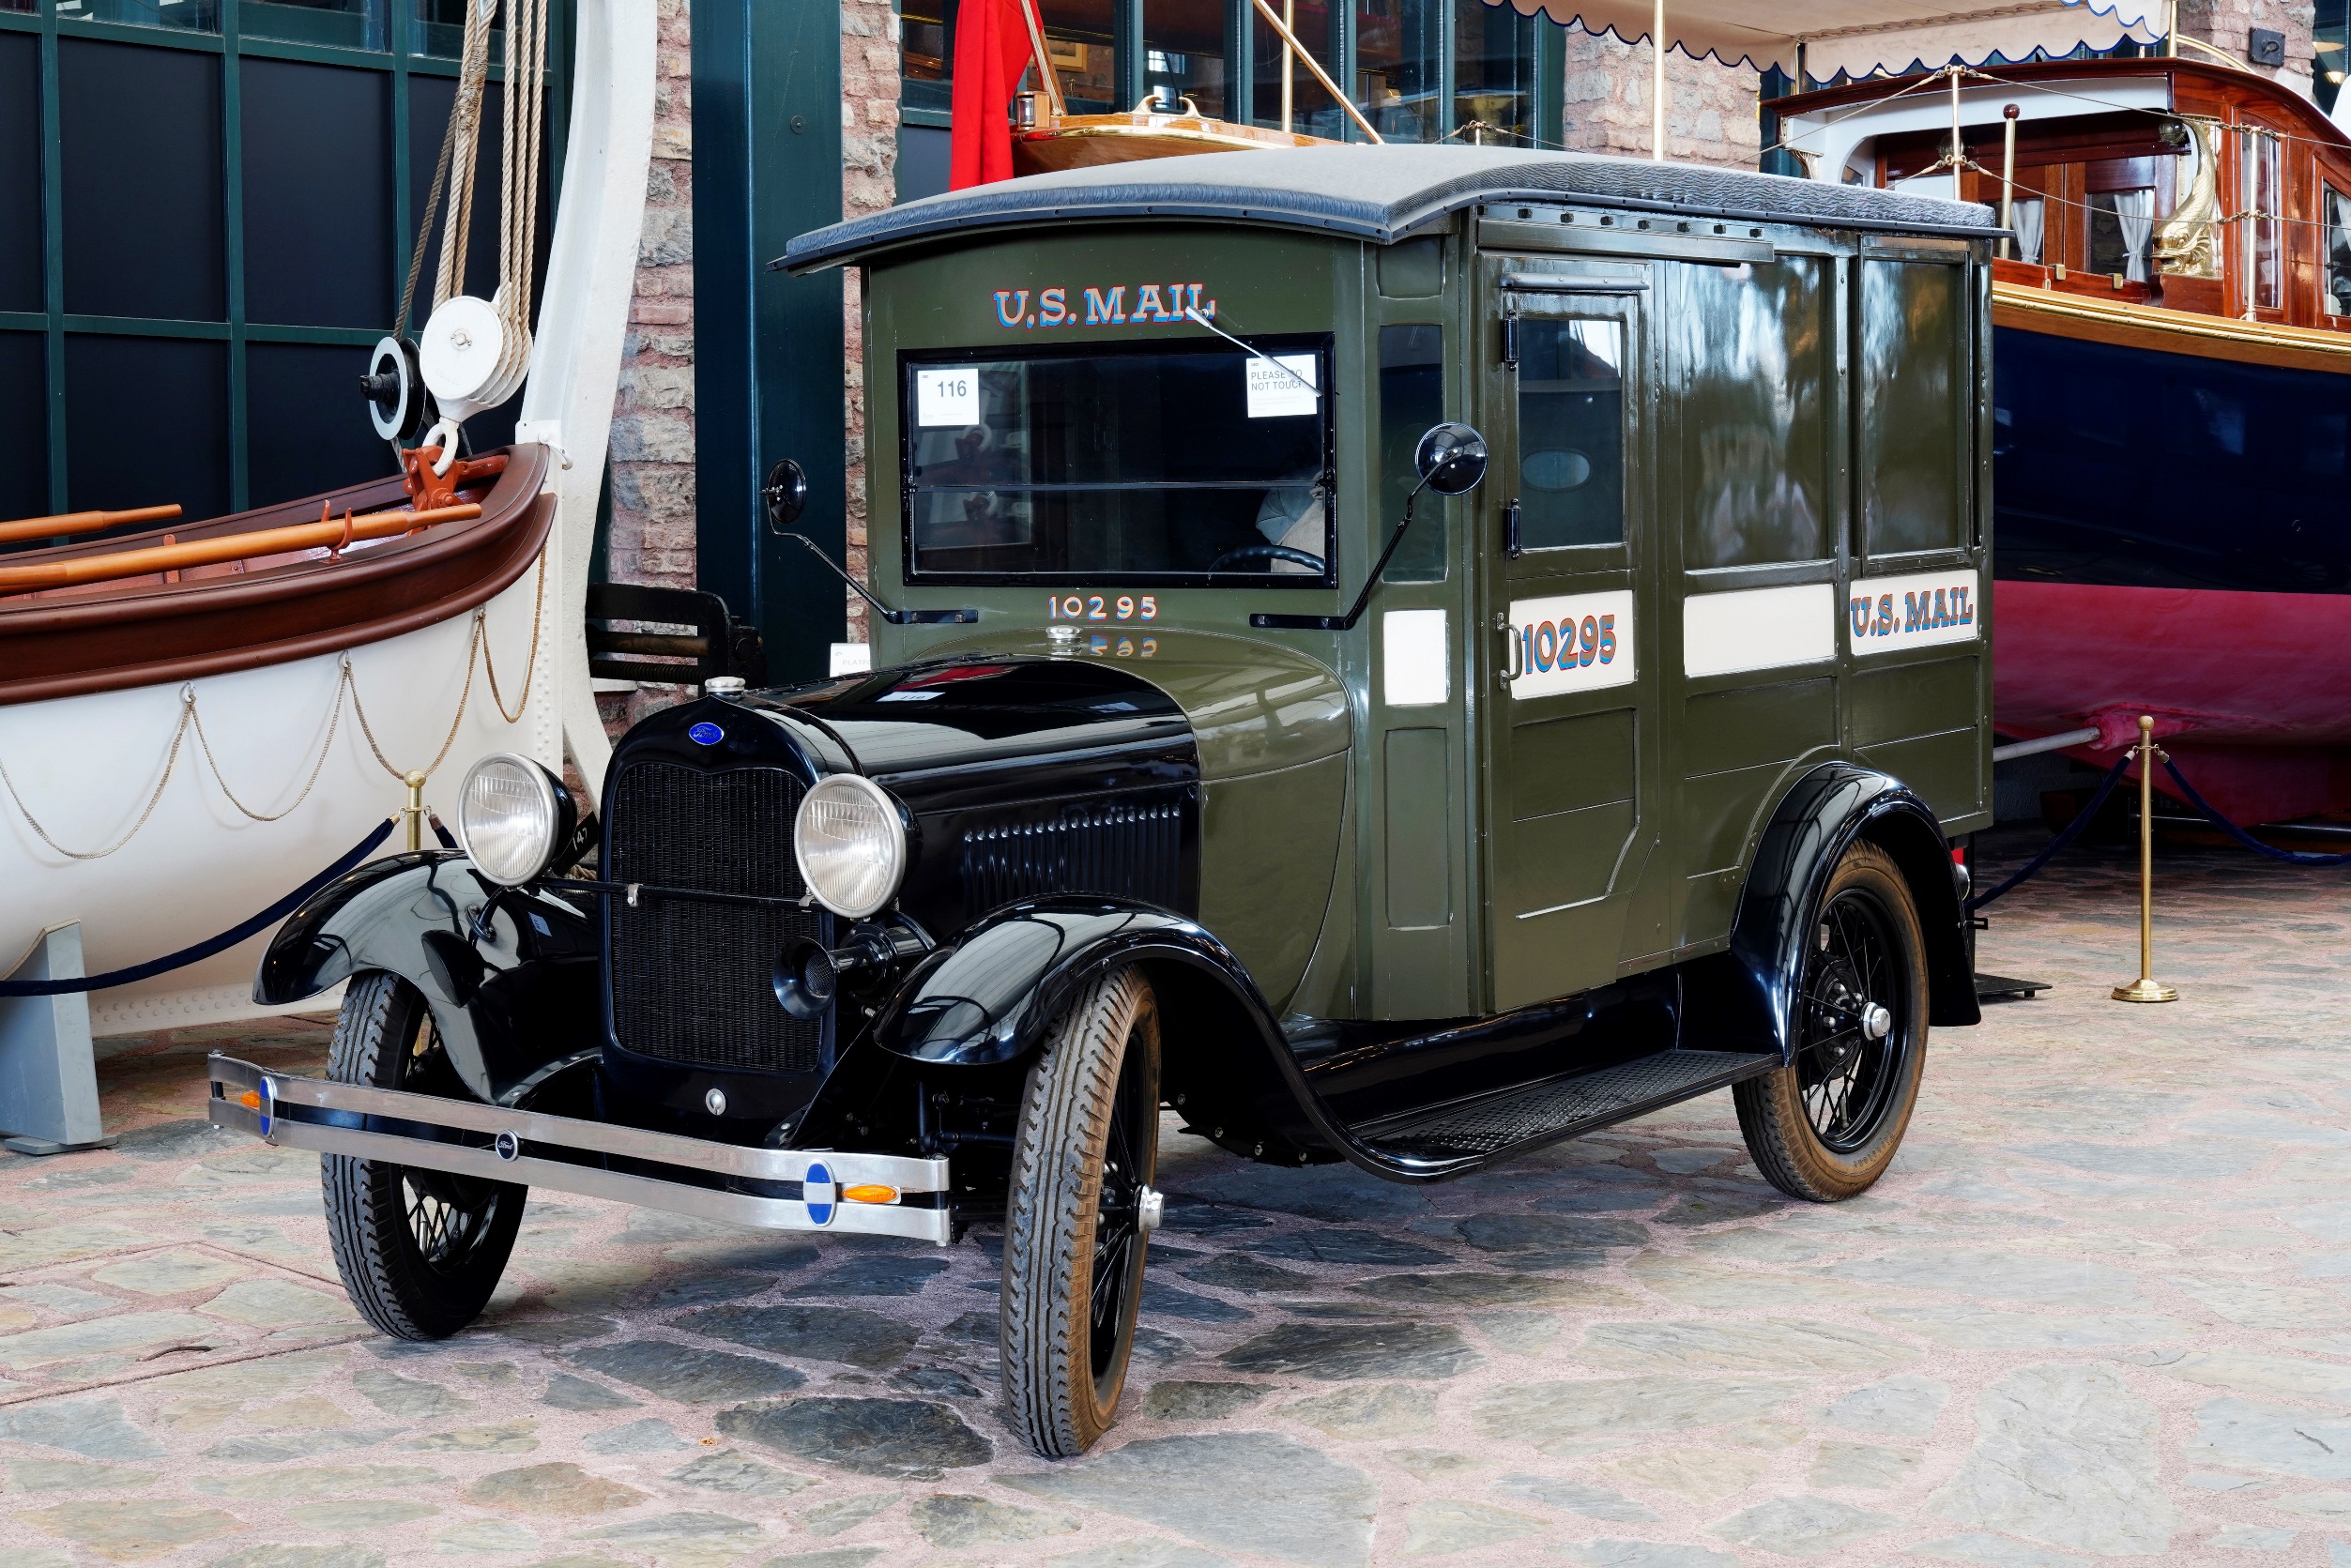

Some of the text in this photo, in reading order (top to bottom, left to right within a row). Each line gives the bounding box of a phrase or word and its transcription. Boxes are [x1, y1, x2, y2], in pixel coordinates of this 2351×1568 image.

[1083, 283, 1216, 326] MAIL
[1251, 370, 1287, 380] PLEASE
[1251, 381, 1270, 391] NOT
[938, 380, 967, 397] 116
[1048, 594, 1158, 621] 10295
[1904, 586, 1974, 632] MAIL
[1522, 615, 1617, 675] 10295
[498, 1140, 513, 1149] Ford
